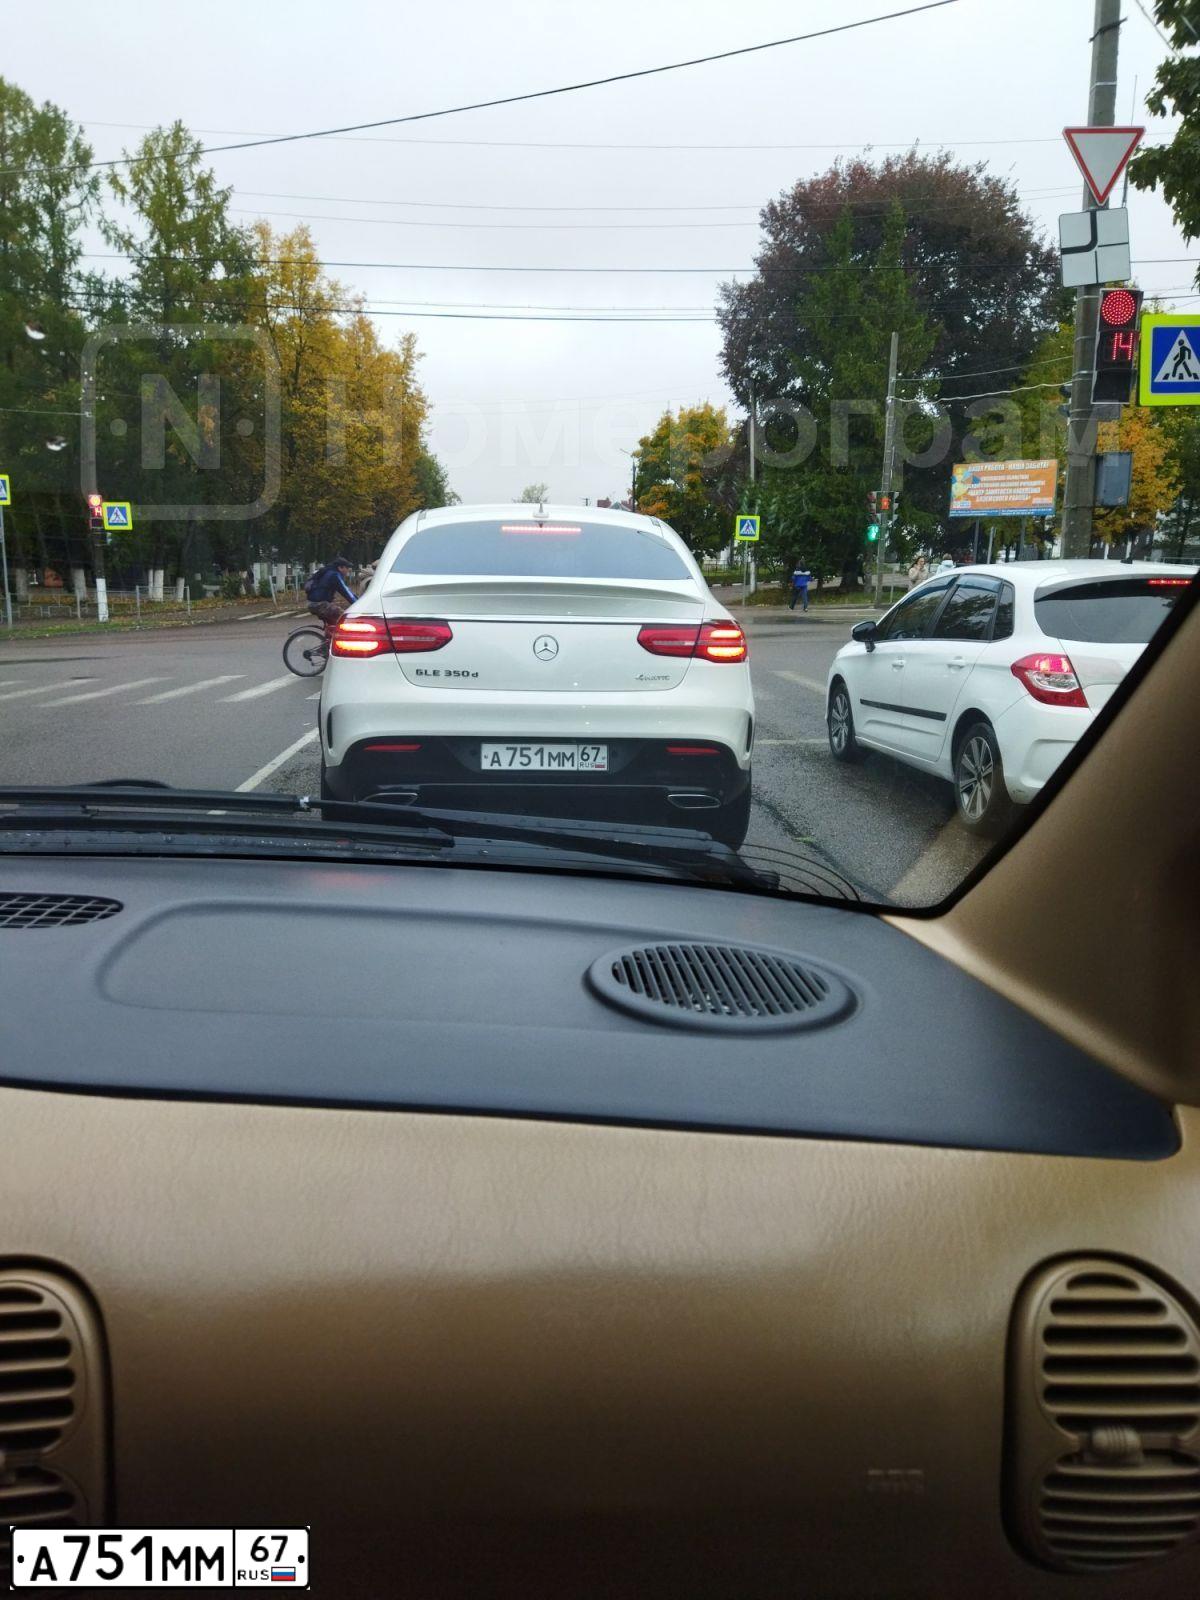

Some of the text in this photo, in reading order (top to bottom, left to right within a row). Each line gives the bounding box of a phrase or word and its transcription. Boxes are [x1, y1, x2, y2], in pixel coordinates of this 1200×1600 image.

[1112, 332, 1133, 361] 14
[416, 668, 440, 677] GLE
[490, 746, 601, 767] А751ММ 67
